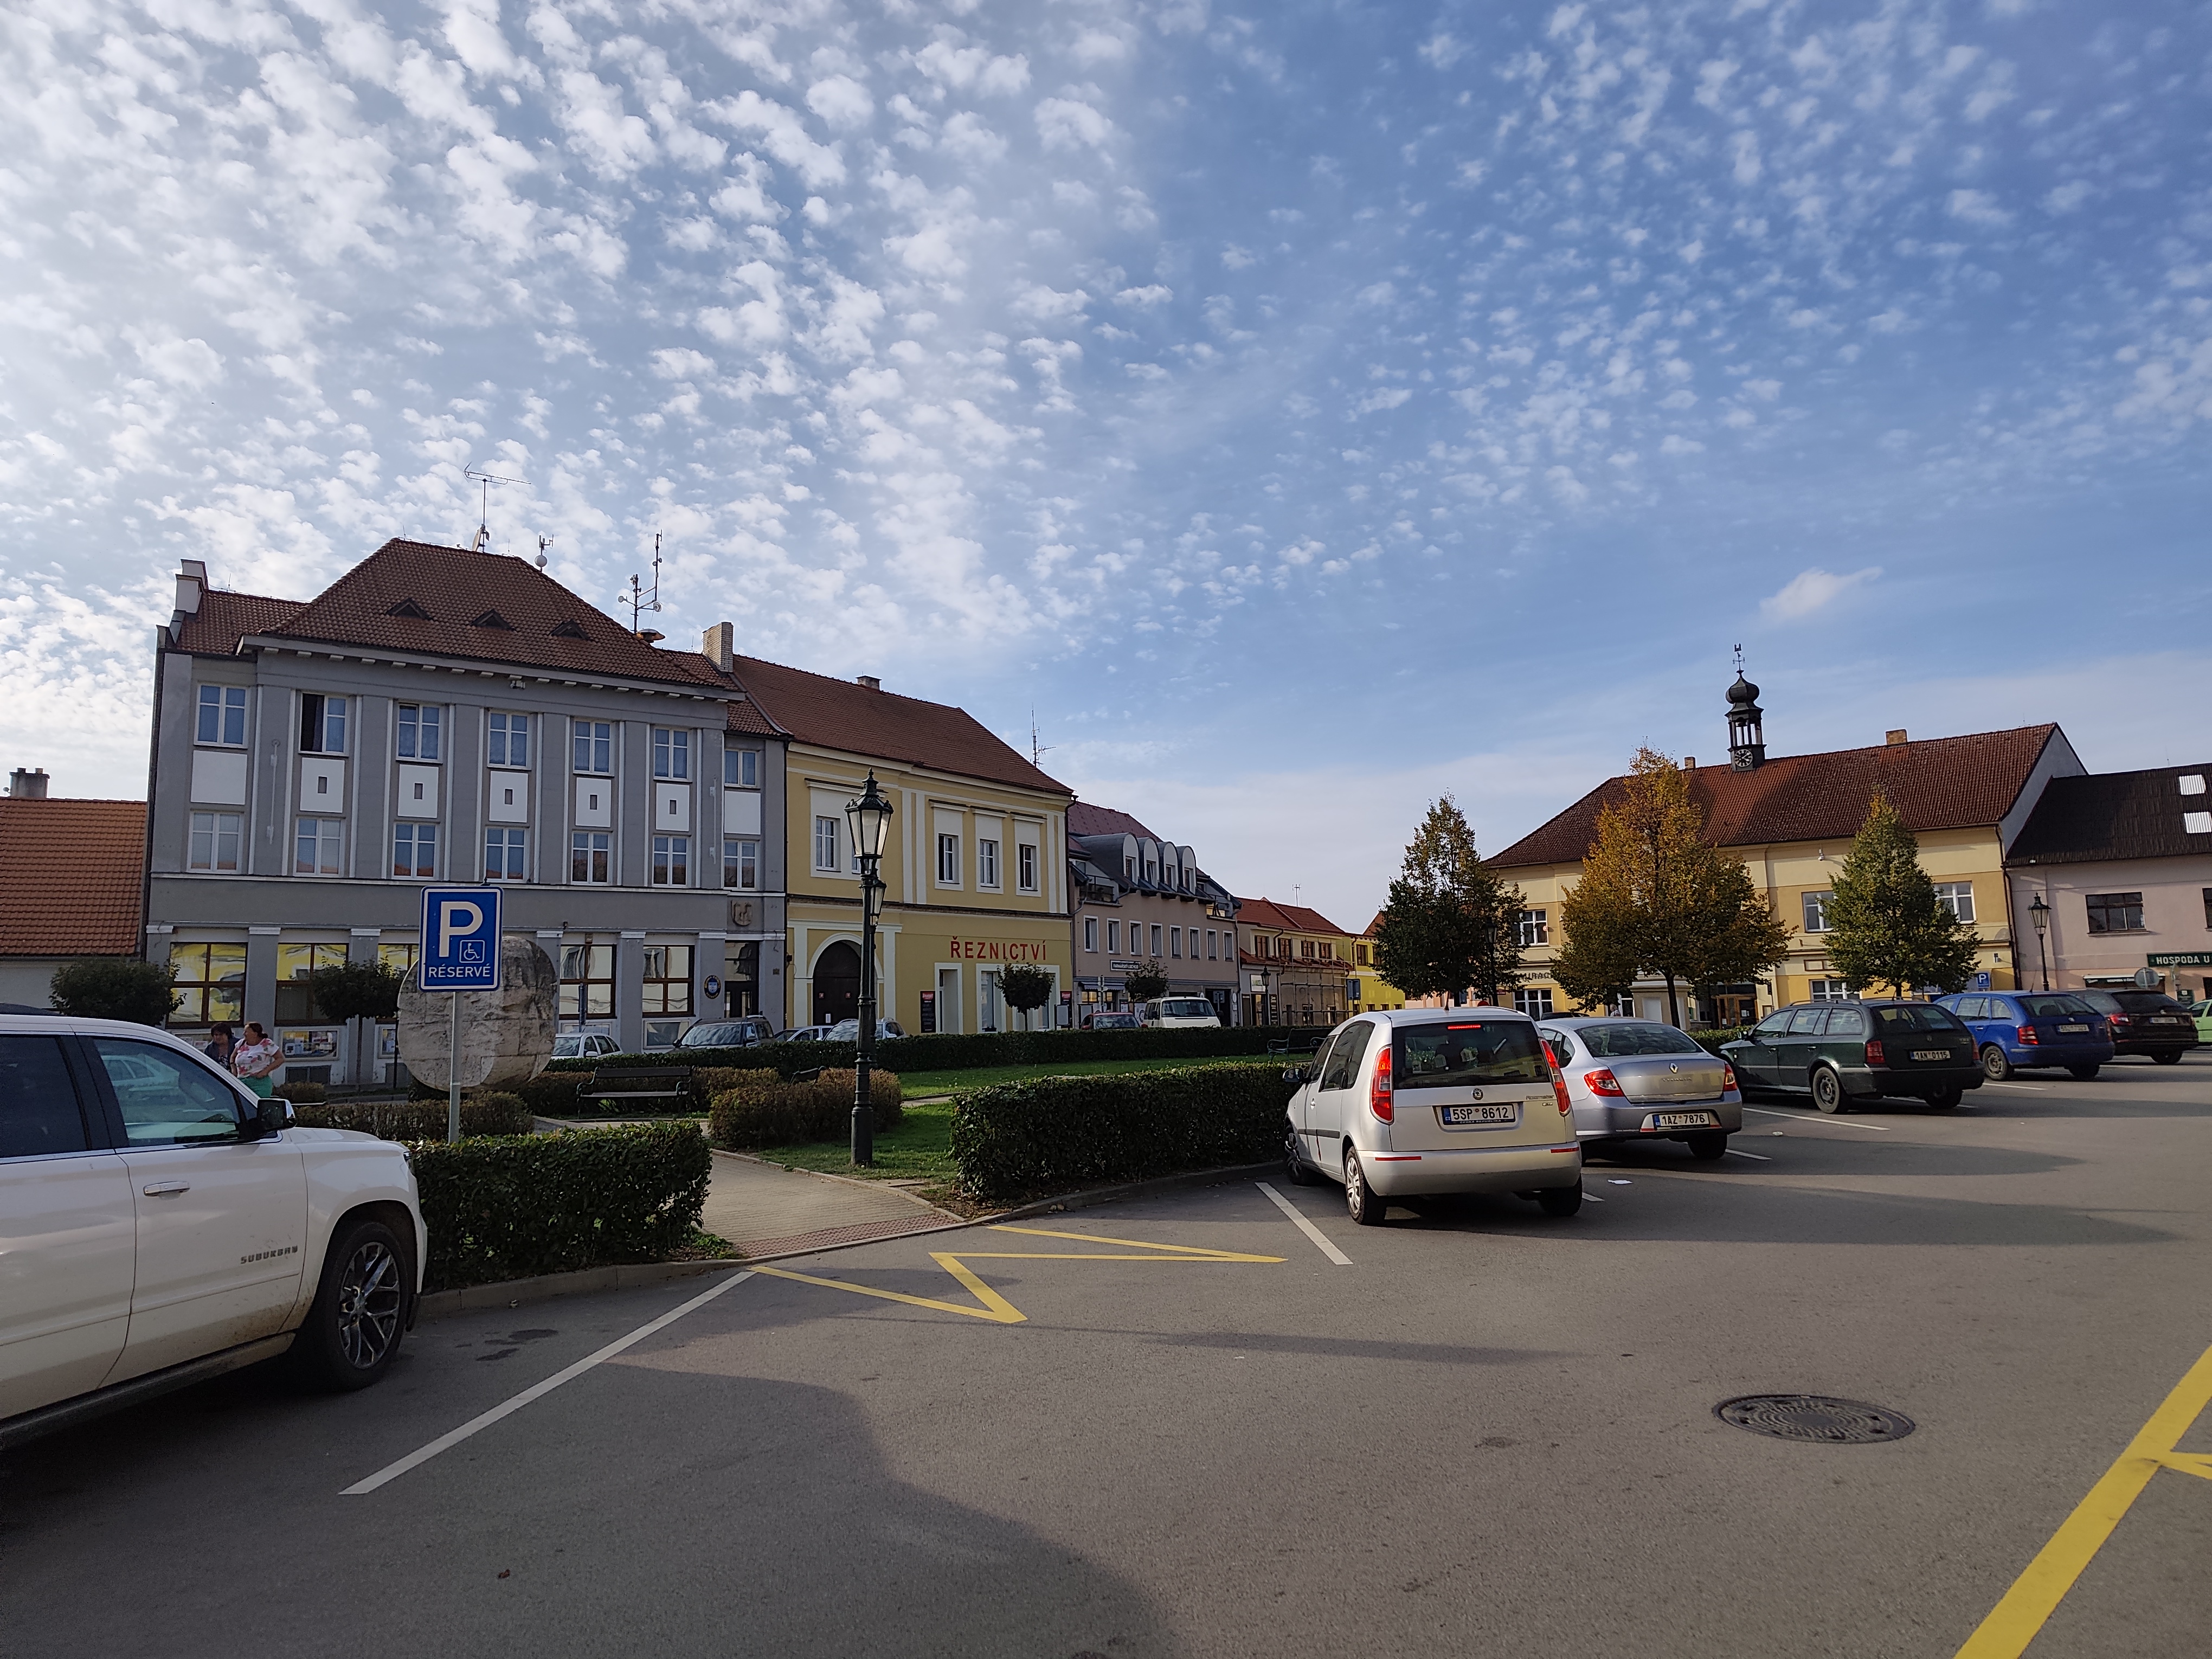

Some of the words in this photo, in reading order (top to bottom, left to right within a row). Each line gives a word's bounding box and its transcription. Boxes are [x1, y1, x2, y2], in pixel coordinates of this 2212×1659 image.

[439, 901, 483, 957] P
[950, 936, 1046, 960] ŘEZNICTVÍ
[2156, 955, 2200, 964] HOSPODA
[2203, 955, 2210, 963] U
[428, 963, 491, 978] RÉSERVÉ
[1979, 974, 1987, 983] P
[1452, 1109, 1473, 1120] 5SP
[1481, 1107, 1509, 1119] 8612
[1662, 1116, 1678, 1125] 1AZ
[1683, 1115, 1706, 1124] 7876
